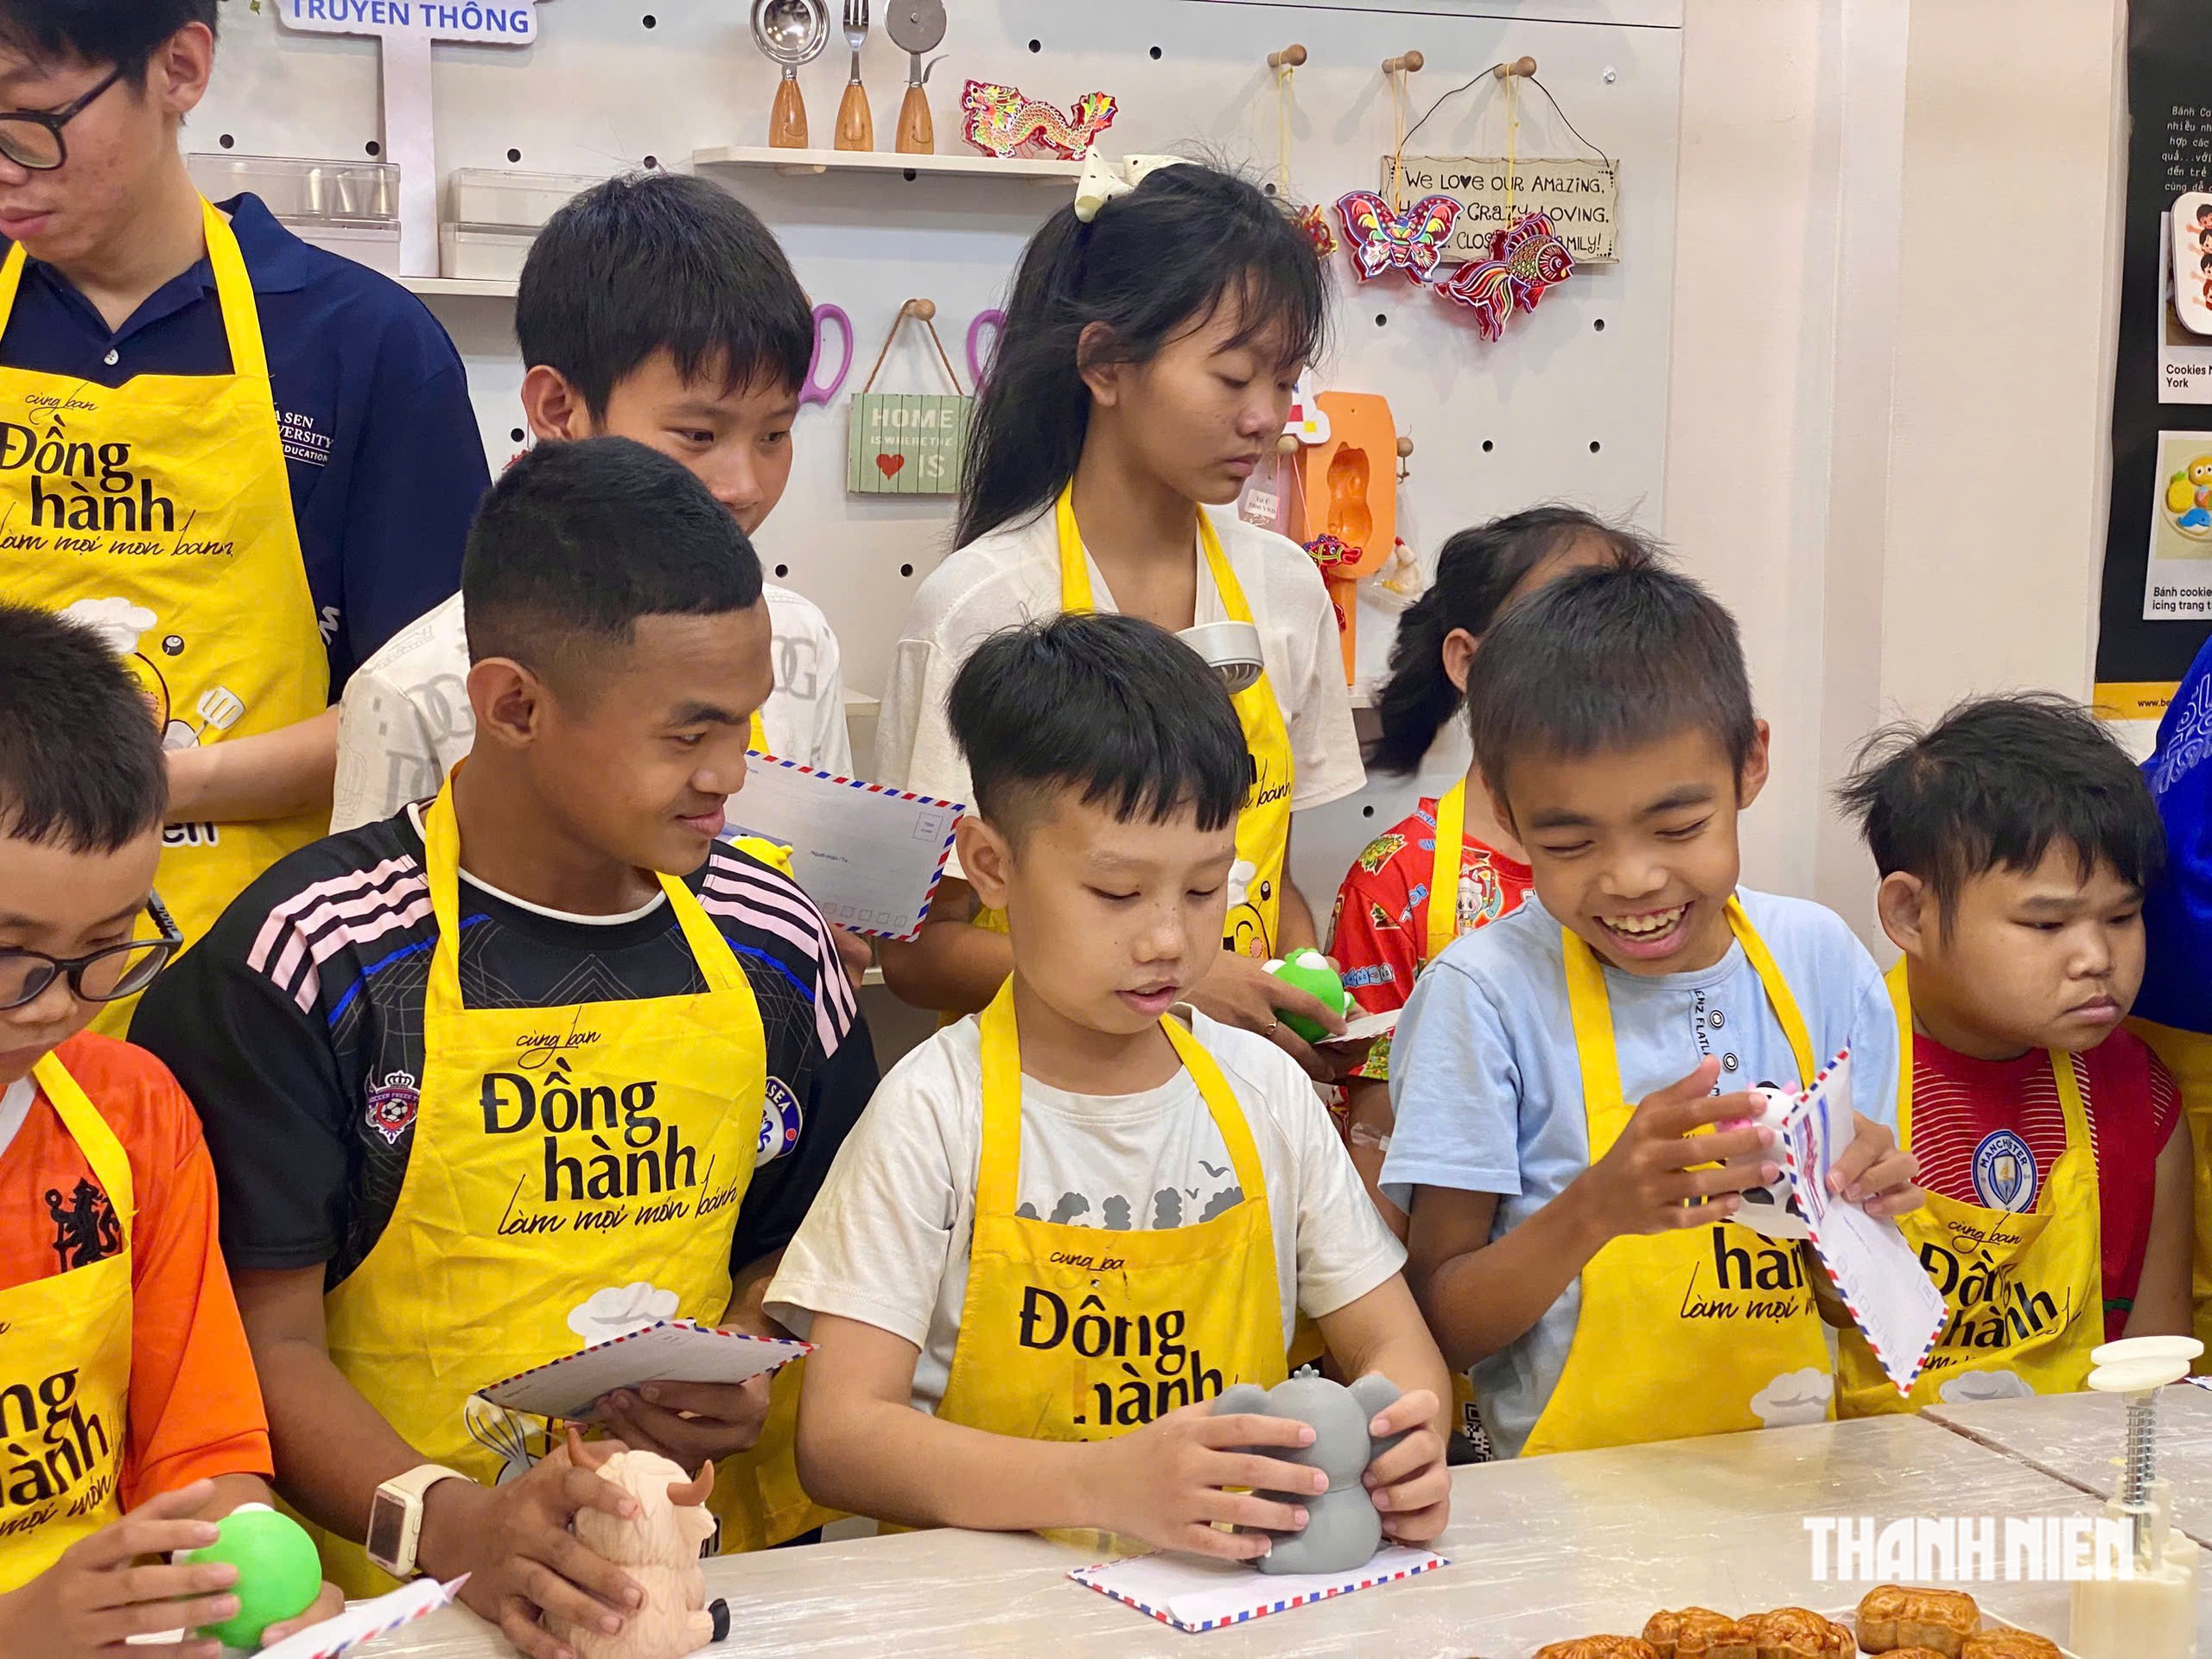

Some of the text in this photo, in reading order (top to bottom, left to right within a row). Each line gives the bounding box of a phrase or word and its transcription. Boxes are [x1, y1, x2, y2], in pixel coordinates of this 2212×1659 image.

[420, 2, 529, 33] THÔNG
[2171, 105, 2195, 116] Bánh
[2166, 120, 2196, 131] nhiều
[2169, 136, 2209, 148] hợp các
[1406, 170, 1433, 189] We
[2166, 364, 2206, 375] Cookies
[2166, 377, 2189, 387] York
[284, 412, 314, 429] SEN
[871, 408, 955, 428] HOME
[870, 435, 952, 447] IS WHERE THE
[0, 414, 134, 493] Đồng
[918, 454, 945, 478] IS
[31, 475, 175, 532] hành
[2153, 587, 2177, 597] Bánh
[2152, 600, 2177, 612] icing
[2178, 601, 2204, 612] trang
[480, 1057, 661, 1147] Đồng
[544, 1125, 696, 1202] hành
[498, 1152, 743, 1235] làm mọi món bánh
[1681, 1261, 1739, 1319] làm
[1745, 1295, 1798, 1324] mọi
[1941, 1281, 2058, 1348] hành
[0, 1367, 79, 1444] ng
[0, 1399, 109, 1508] ành
